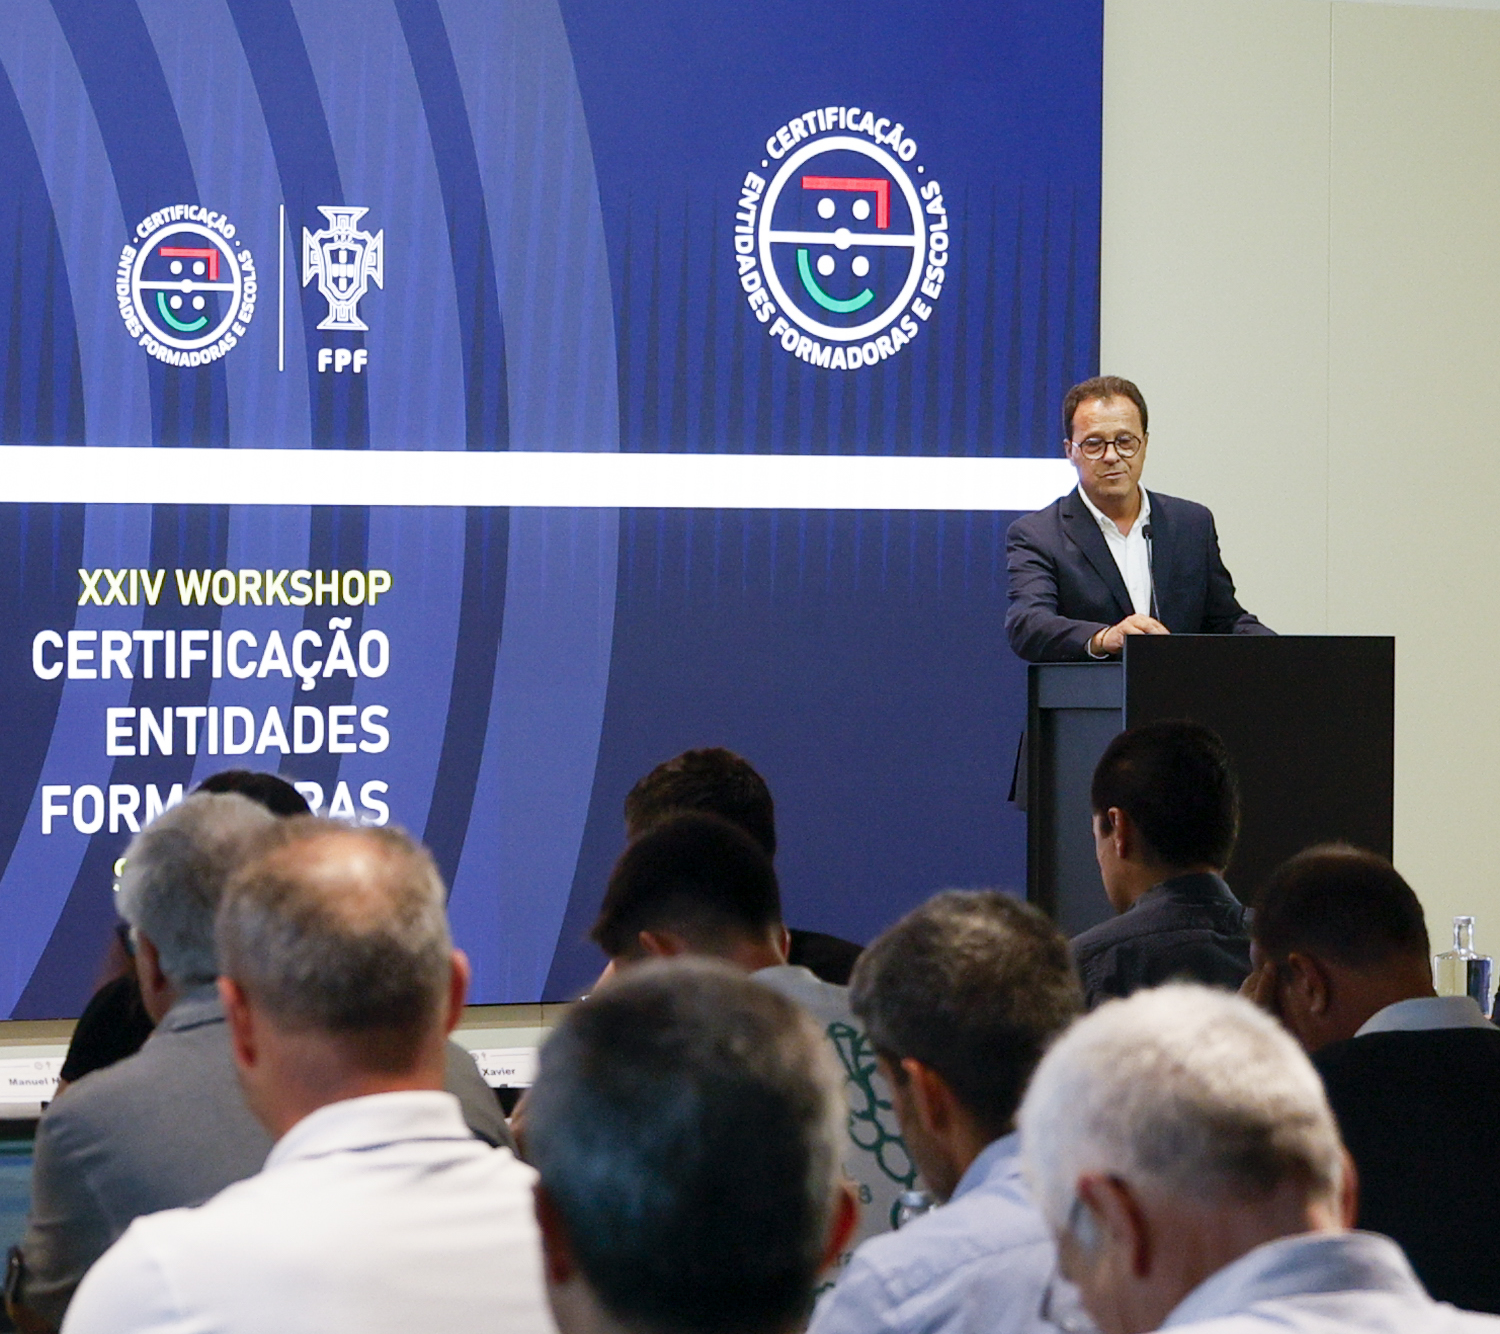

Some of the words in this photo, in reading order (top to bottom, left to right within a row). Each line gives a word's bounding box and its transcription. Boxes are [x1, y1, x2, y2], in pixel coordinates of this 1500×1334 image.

[765, 106, 918, 163] CERTIFICAÇÃO
[136, 203, 236, 240] CERTIFICAÇÃO
[733, 171, 776, 324] ENTIDADES
[920, 179, 950, 301] ESCOLAS
[115, 244, 142, 339] ENTIDADES
[237, 249, 258, 324] ESCOLAS
[913, 298, 933, 322] E
[138, 333, 238, 368] FORMADORAS
[232, 321, 247, 338] E
[768, 316, 920, 371] FORMADORAS
[316, 348, 369, 374] FPF
[78, 568, 165, 606] XXIV
[176, 567, 392, 606] WORKSHOP
[32, 616, 391, 691] CERTIFICAÇÃO
[105, 705, 391, 757] ENTIDADES
[41, 779, 391, 835] FORMRAS
[8, 1077, 49, 1086] Manuel
[482, 1067, 516, 1076] Xavier
